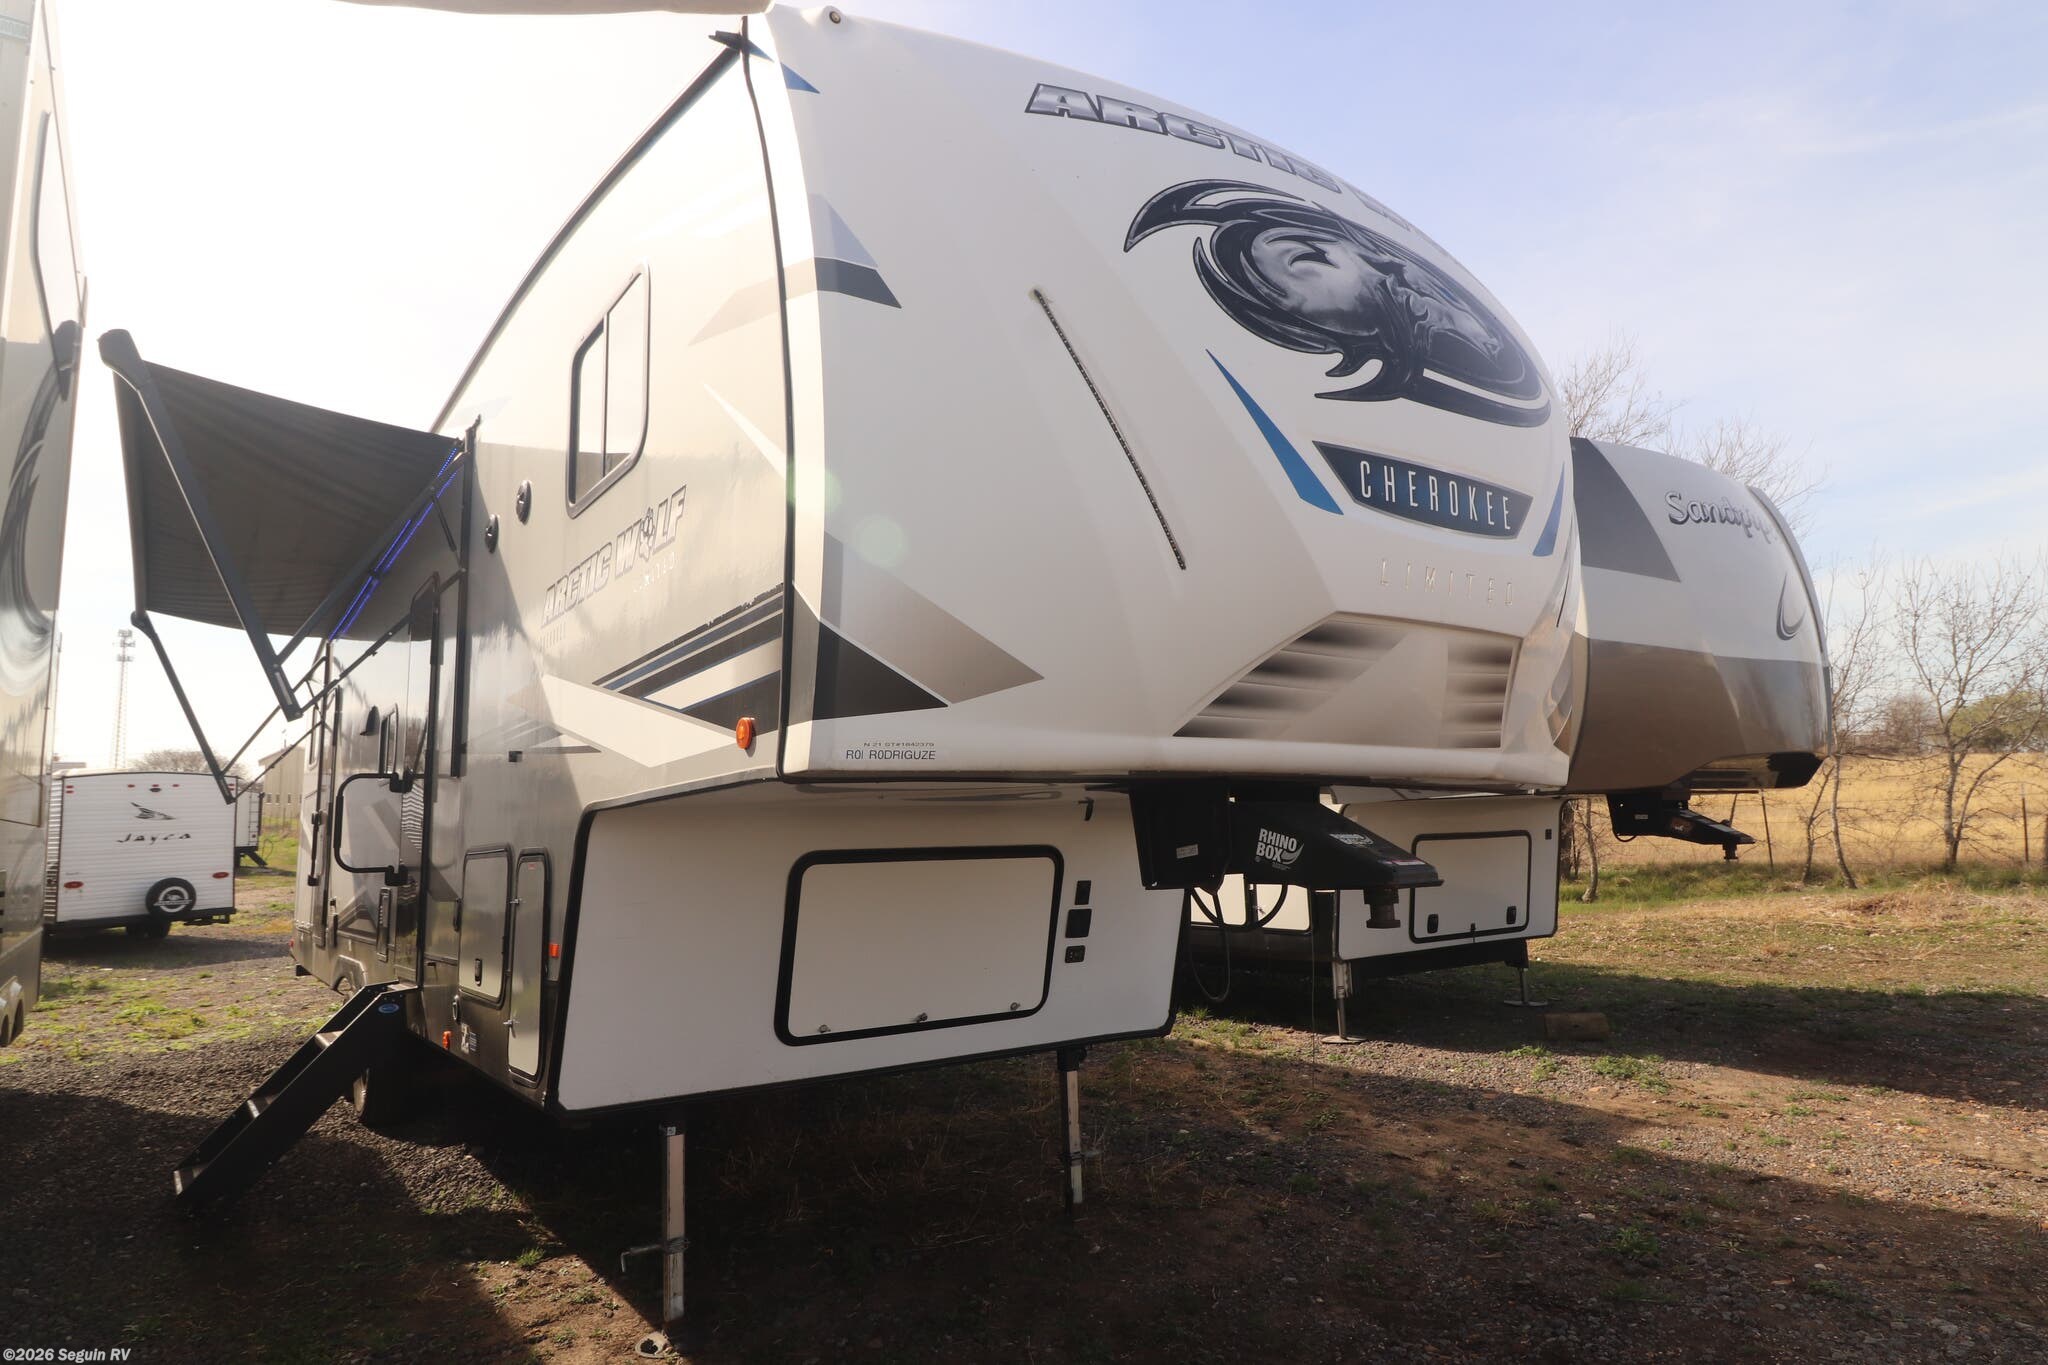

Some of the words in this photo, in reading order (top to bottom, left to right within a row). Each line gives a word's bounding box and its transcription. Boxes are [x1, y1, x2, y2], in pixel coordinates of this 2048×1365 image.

[1024, 83, 1343, 194] ARCTIC
[1359, 460, 1512, 530] CHEROKEE
[541, 541, 613, 629] ARCTIC
[1377, 558, 1514, 607] LIMITED
[1255, 841, 1284, 863] BOX
[1258, 828, 1298, 853] RHINO
